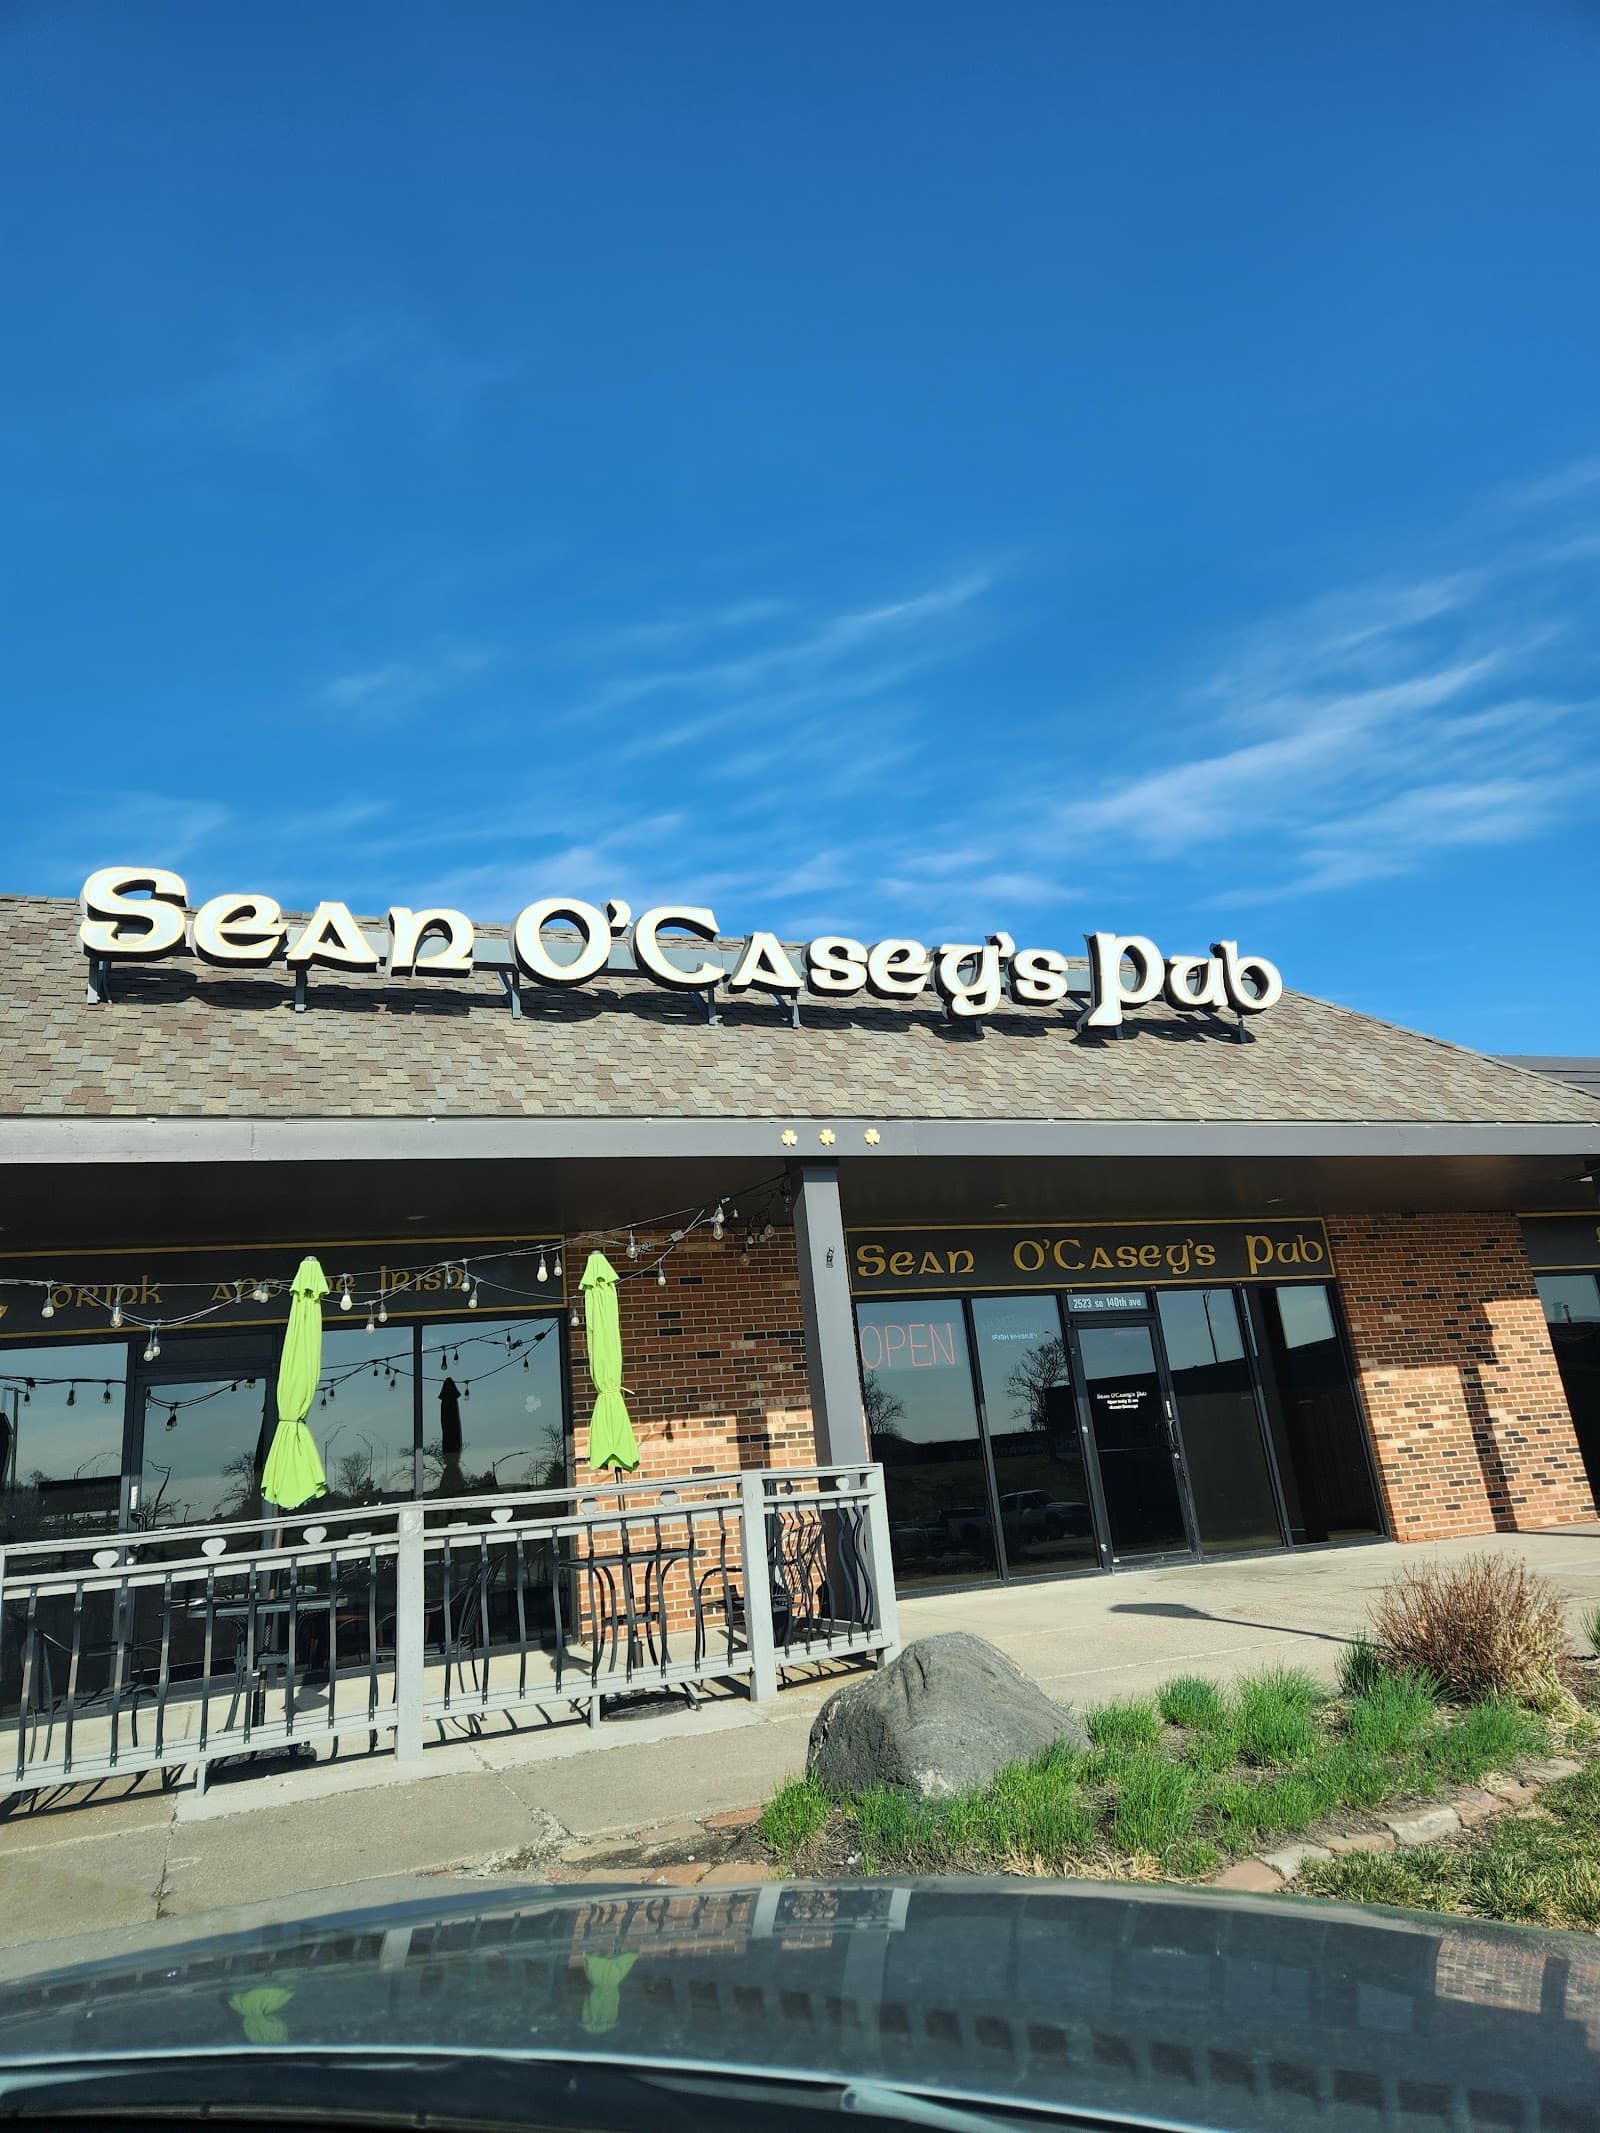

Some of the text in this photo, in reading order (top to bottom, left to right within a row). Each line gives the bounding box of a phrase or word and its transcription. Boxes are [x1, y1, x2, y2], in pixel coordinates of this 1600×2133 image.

[79, 866, 1283, 1029] Sean O'Casey's Pub
[856, 1233, 1325, 1277] Sean O'Casey's Pub
[1073, 1298, 1092, 1309] 2523
[1106, 1297, 1128, 1308] 140th
[860, 1321, 955, 1371] OPEN
